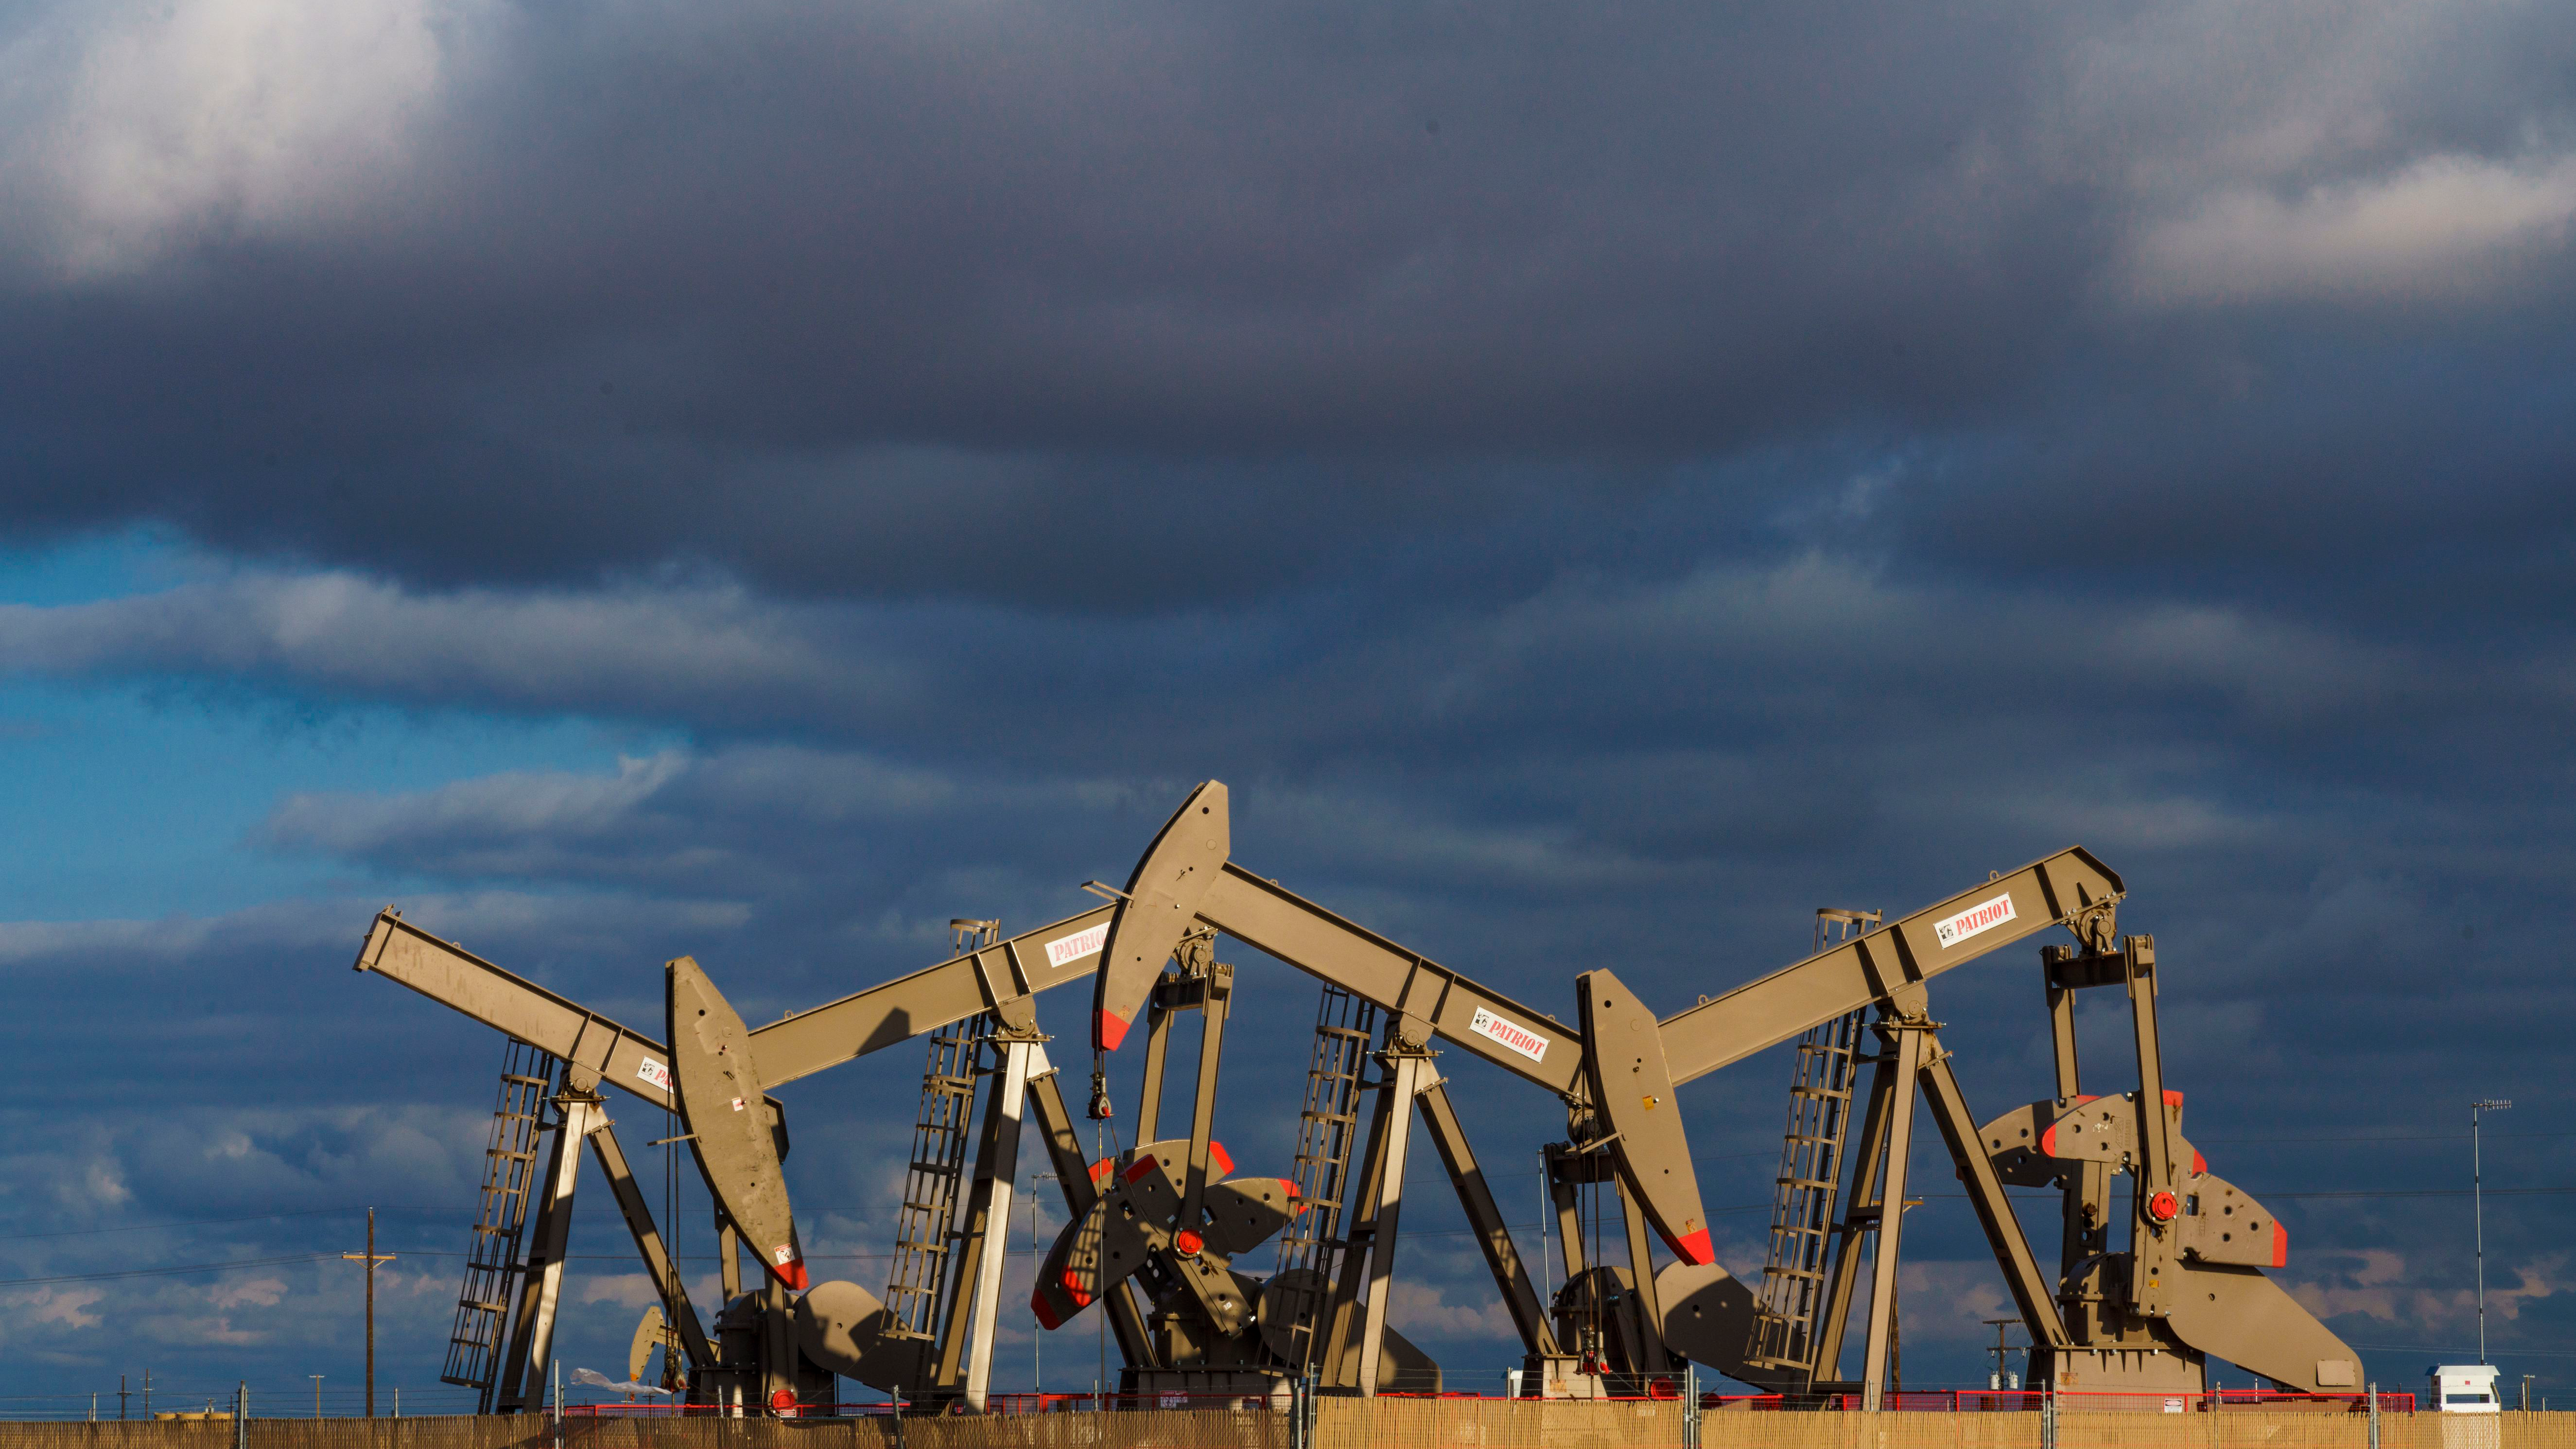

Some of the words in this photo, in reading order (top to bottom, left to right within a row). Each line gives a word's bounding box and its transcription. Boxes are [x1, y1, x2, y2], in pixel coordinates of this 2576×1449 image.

[1956, 899, 2009, 935] PATRIOT
[1054, 927, 1109, 961] PATRIO
[1488, 1020, 1545, 1055] PATRIOT
